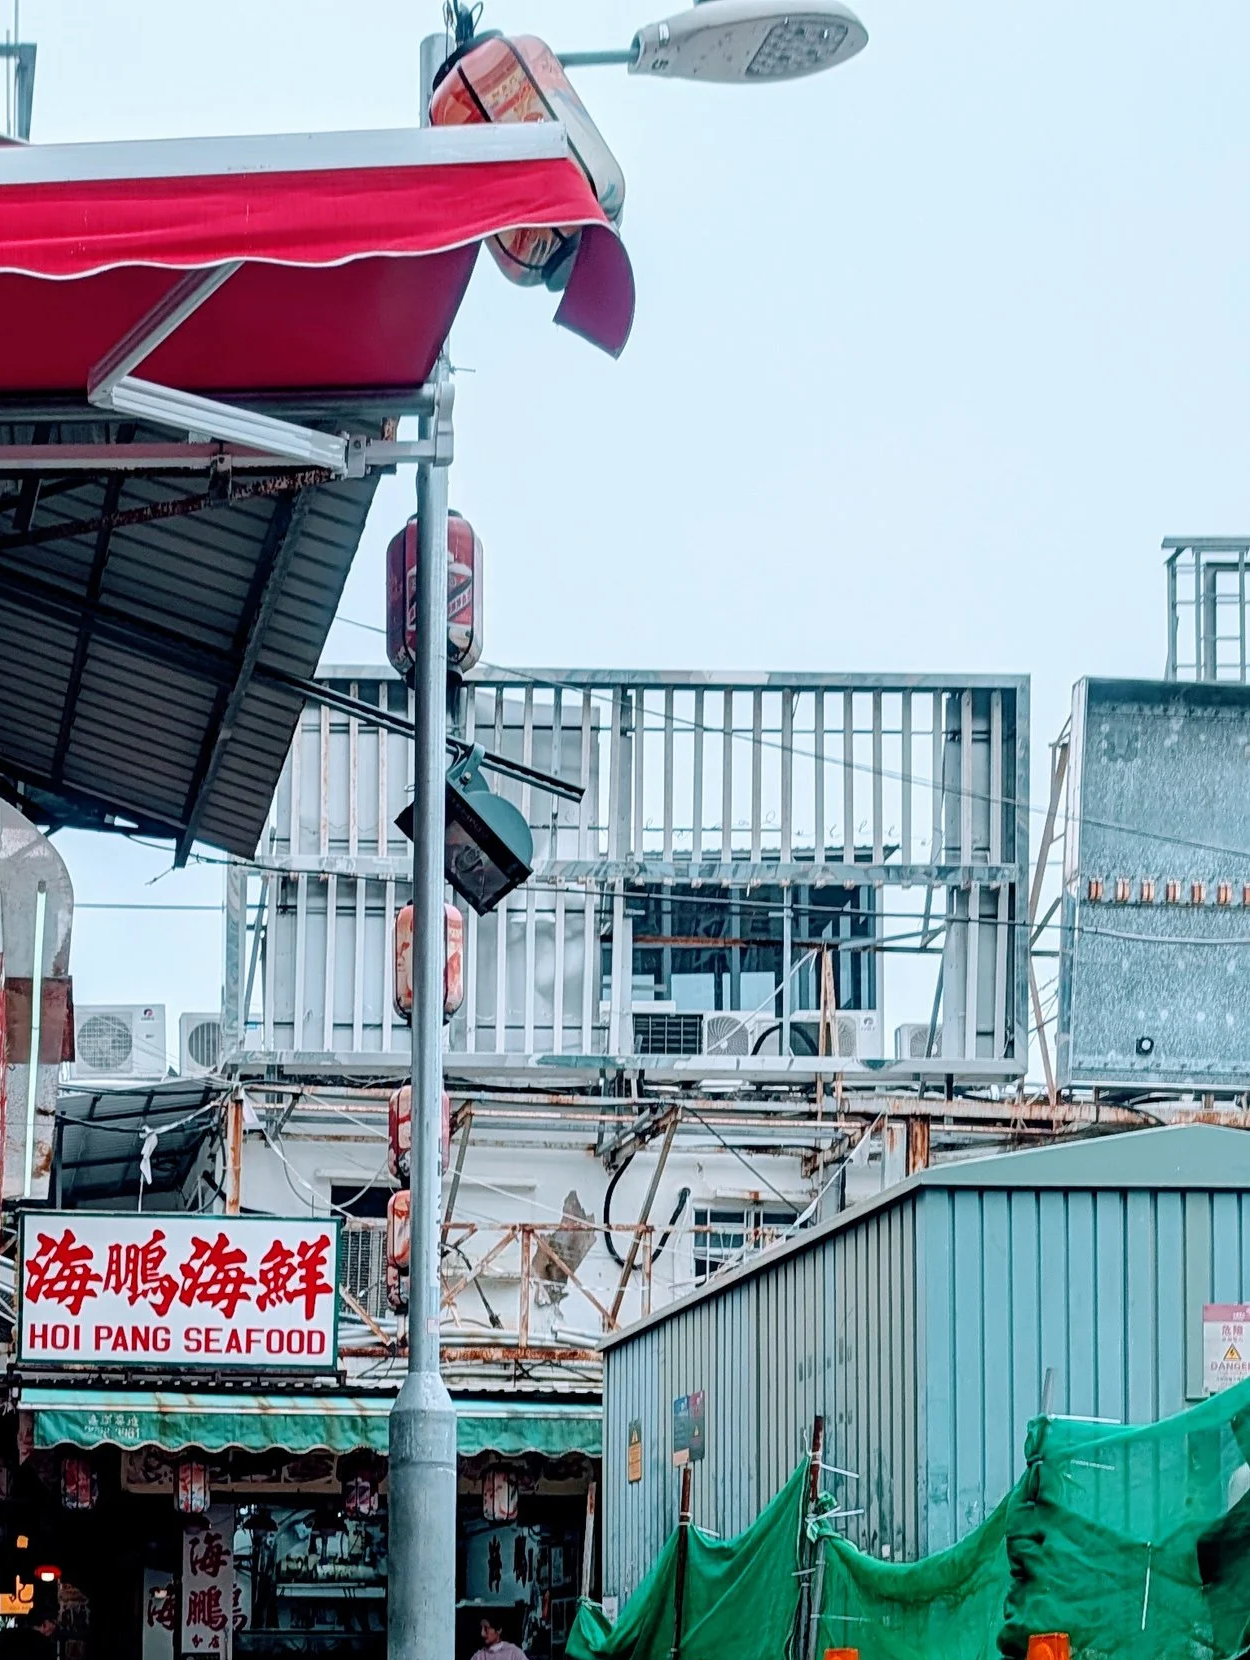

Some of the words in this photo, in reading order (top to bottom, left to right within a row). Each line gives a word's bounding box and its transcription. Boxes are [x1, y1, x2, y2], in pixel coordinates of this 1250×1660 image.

[25, 1228, 333, 1321] 海鵬海鮮
[29, 1323, 81, 1351] HOI
[94, 1325, 171, 1352] PANG
[183, 1327, 326, 1356] SEAFOOD
[186, 1531, 231, 1632] 海鵬
